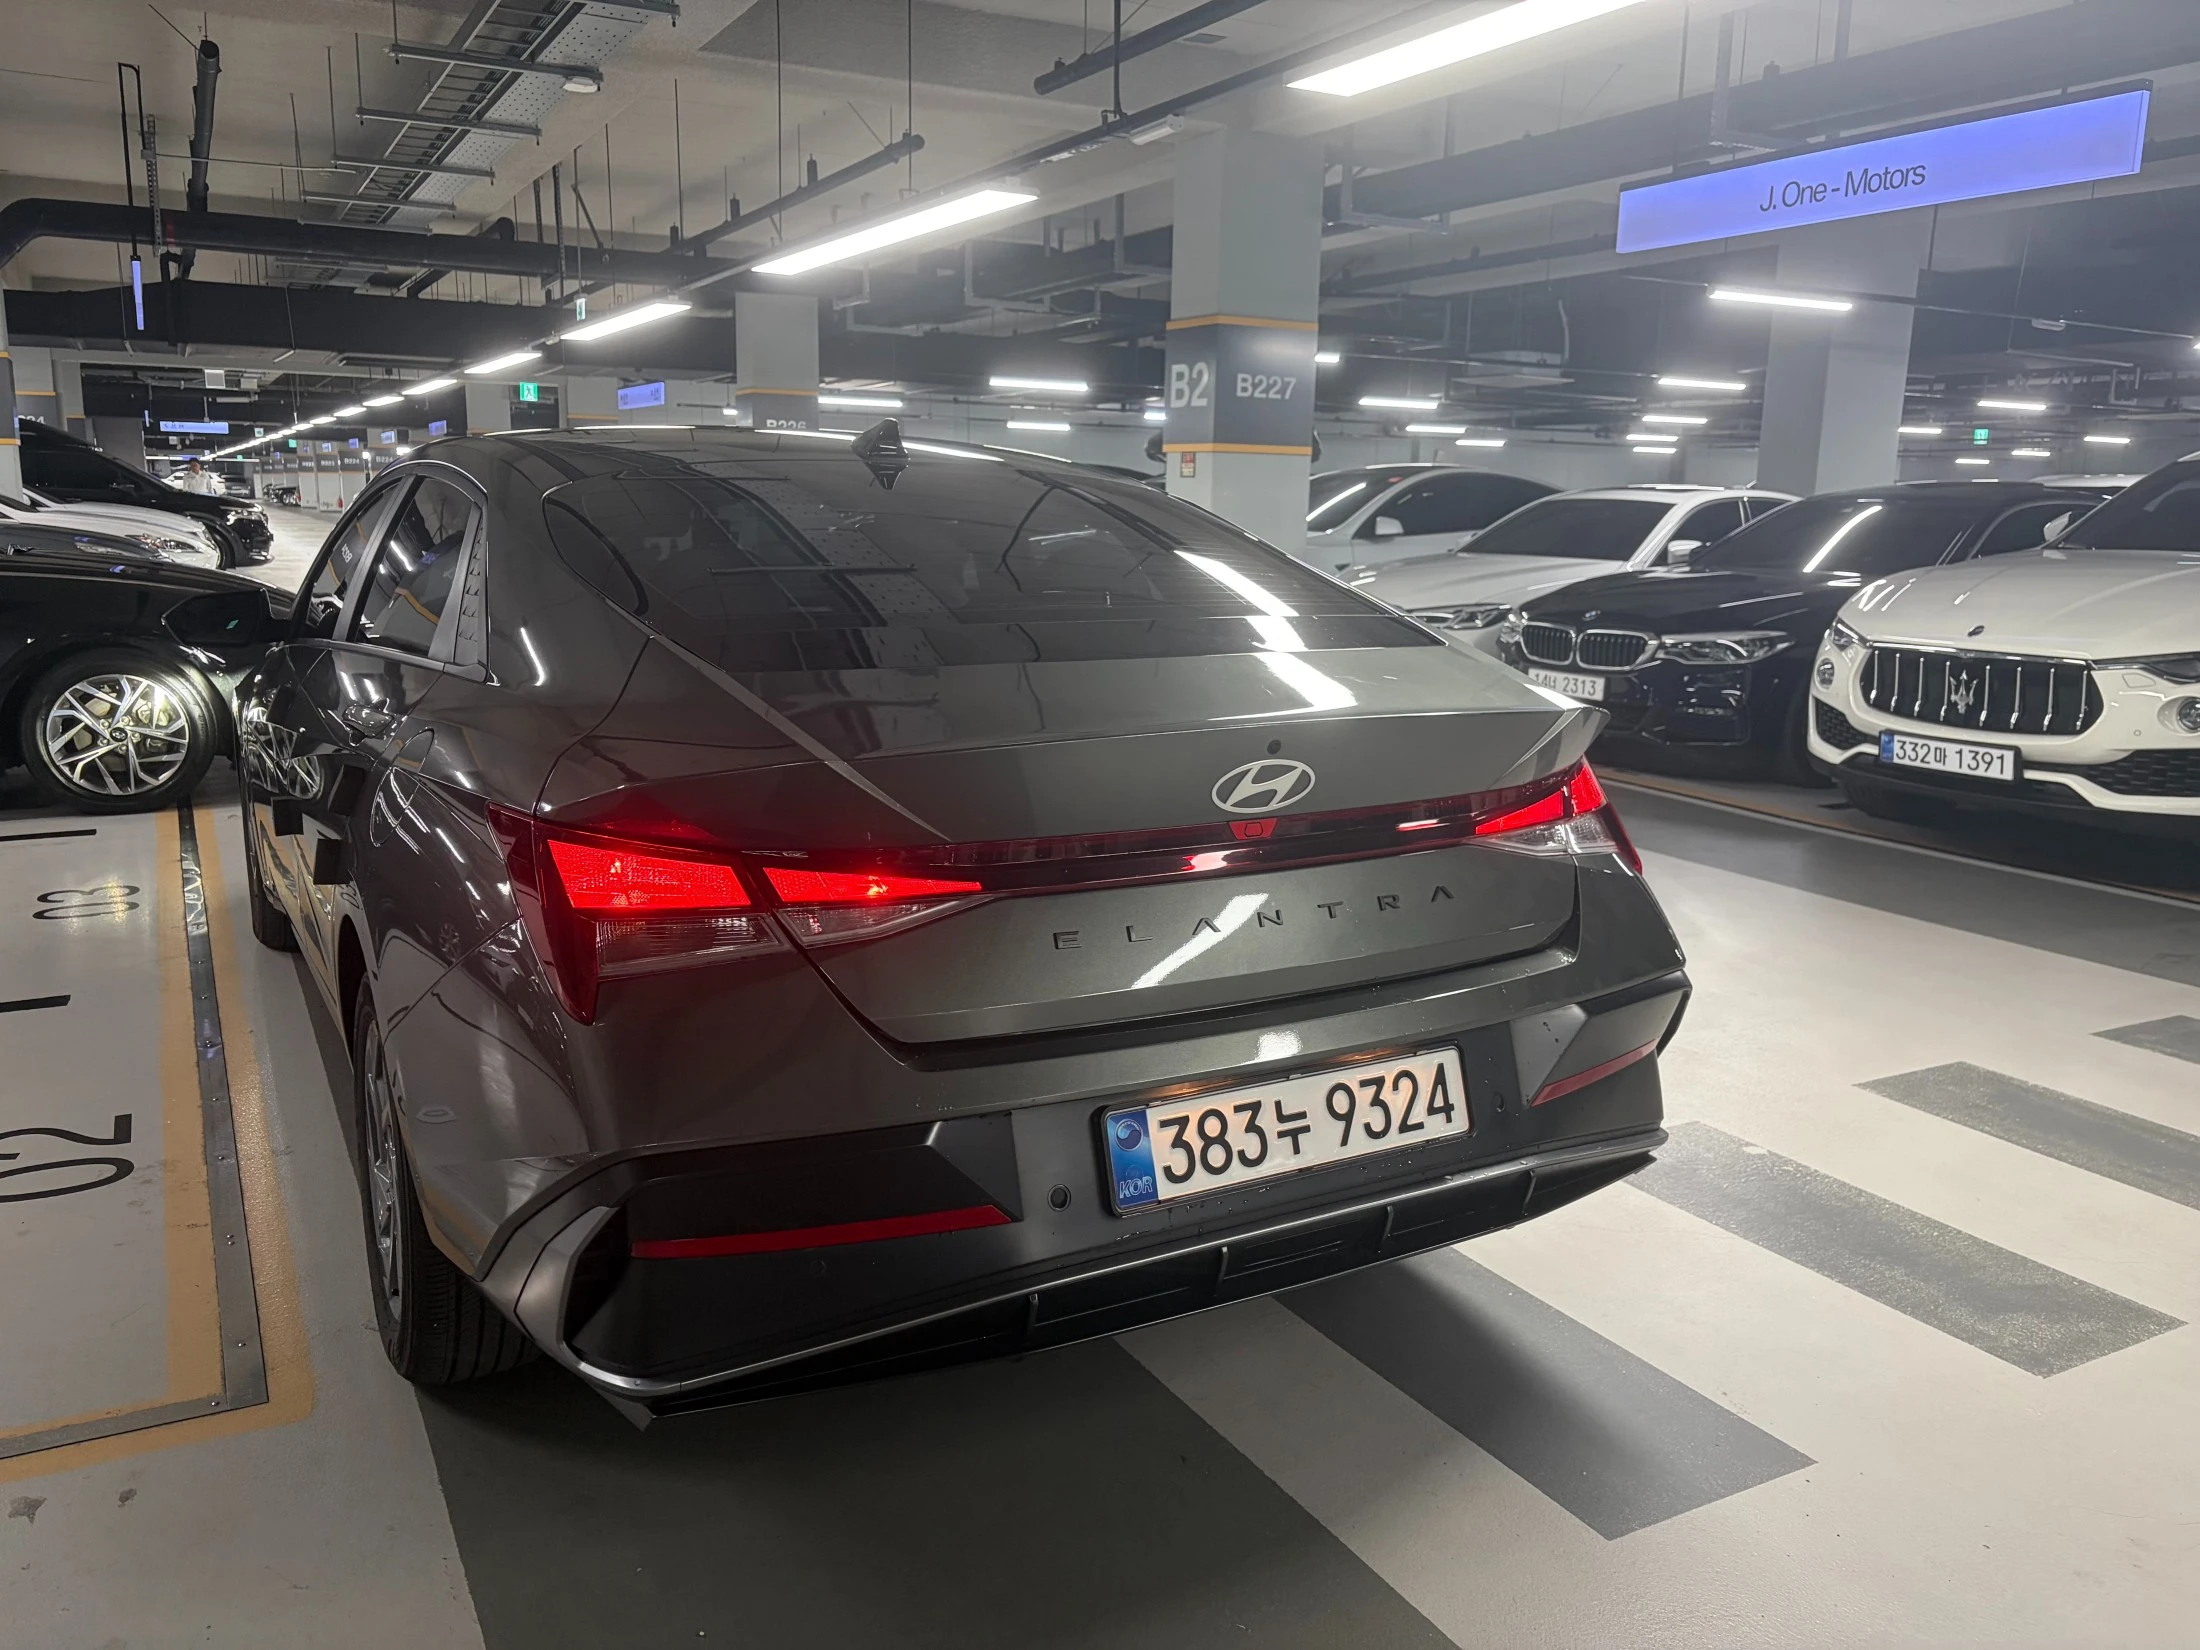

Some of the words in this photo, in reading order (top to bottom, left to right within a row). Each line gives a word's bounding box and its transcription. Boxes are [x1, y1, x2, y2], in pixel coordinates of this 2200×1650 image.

[1782, 181, 1827, 208] One
[1845, 164, 1926, 197] Motors
[1170, 361, 1209, 408] B2
[1236, 372, 1297, 399] B227
[1562, 676, 1596, 696] 2313
[1895, 739, 1947, 766] 332마
[1955, 747, 2005, 775] 1391
[1053, 885, 1455, 950] ELANTRA
[1157, 1099, 1312, 1184] 383누
[1325, 1061, 1456, 1147] 9324
[1119, 1175, 1153, 1199] KOR
